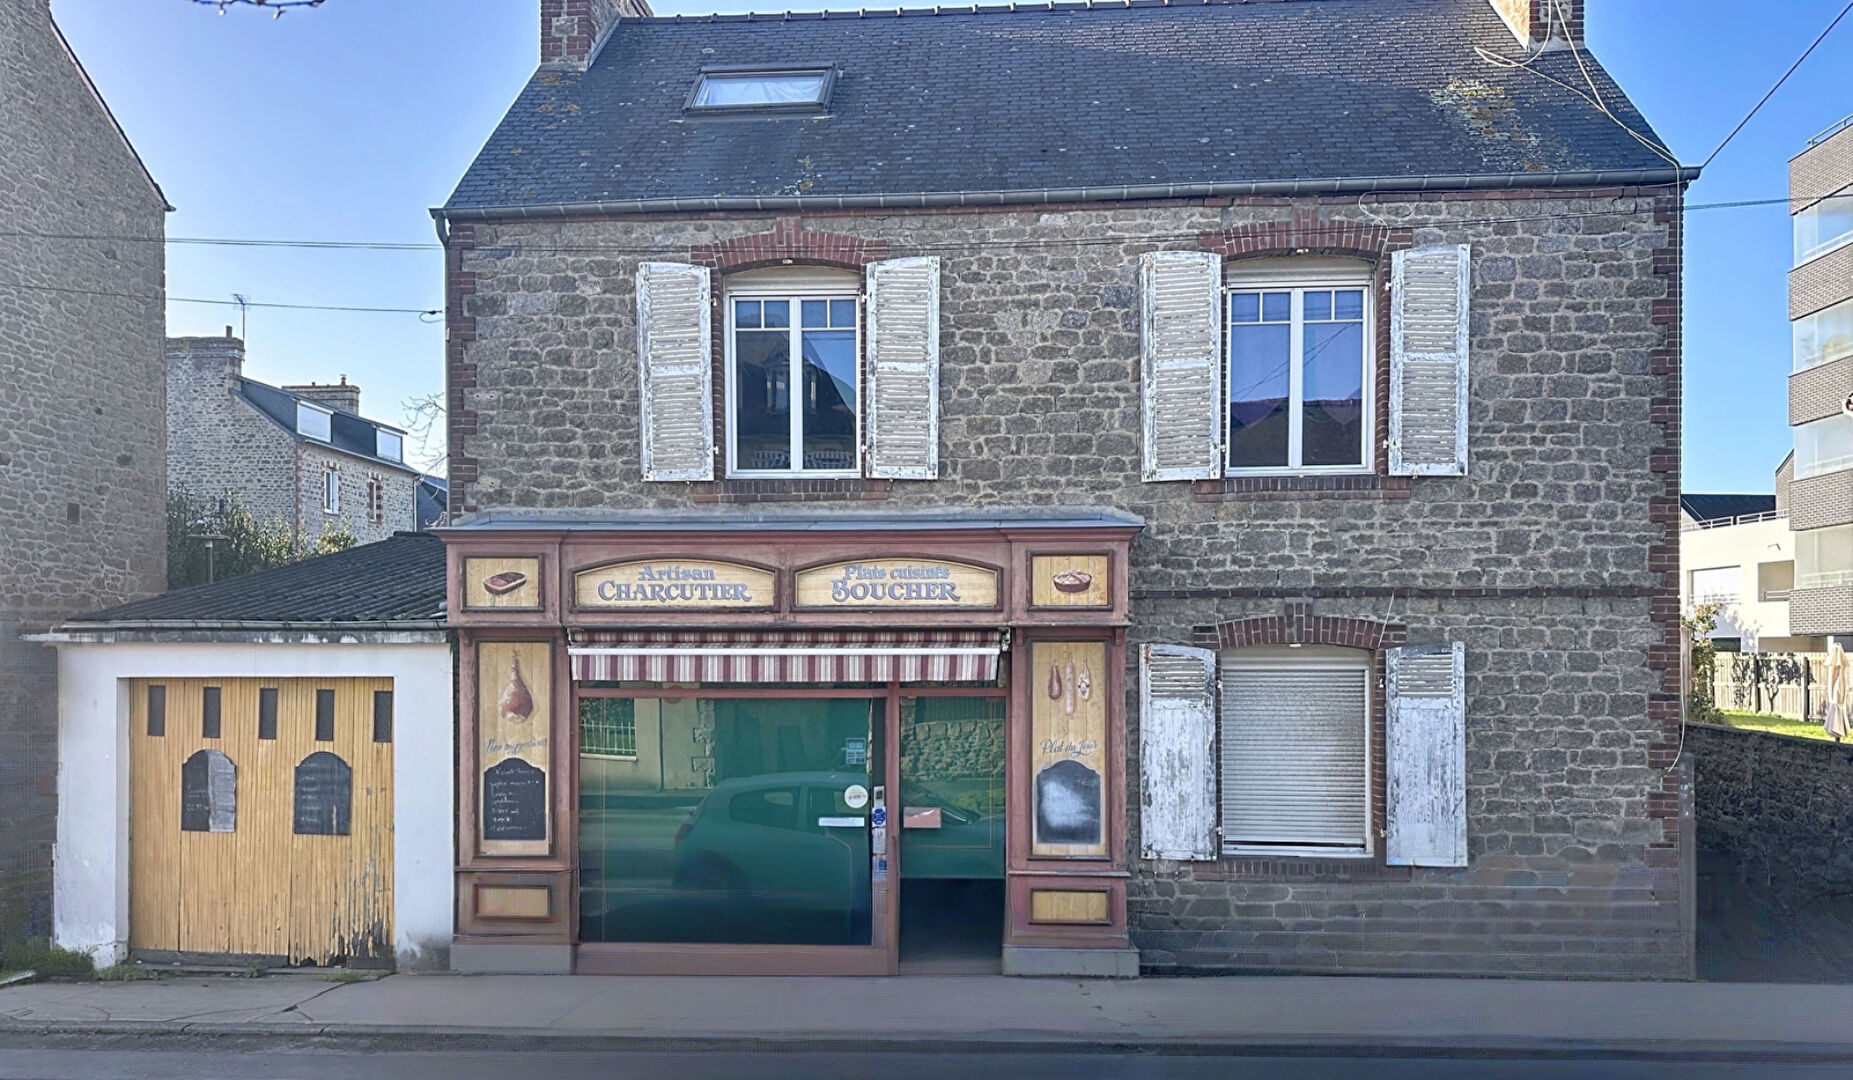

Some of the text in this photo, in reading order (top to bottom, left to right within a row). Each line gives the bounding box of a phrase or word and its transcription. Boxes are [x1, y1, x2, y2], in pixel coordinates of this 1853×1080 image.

[638, 565, 716, 581] Artisan
[843, 565, 886, 580] Plats
[597, 579, 752, 603] CHARCUTIER
[831, 577, 961, 603] BOUCHER
[1040, 738, 1064, 755] Plat
[1065, 742, 1076, 752] du
